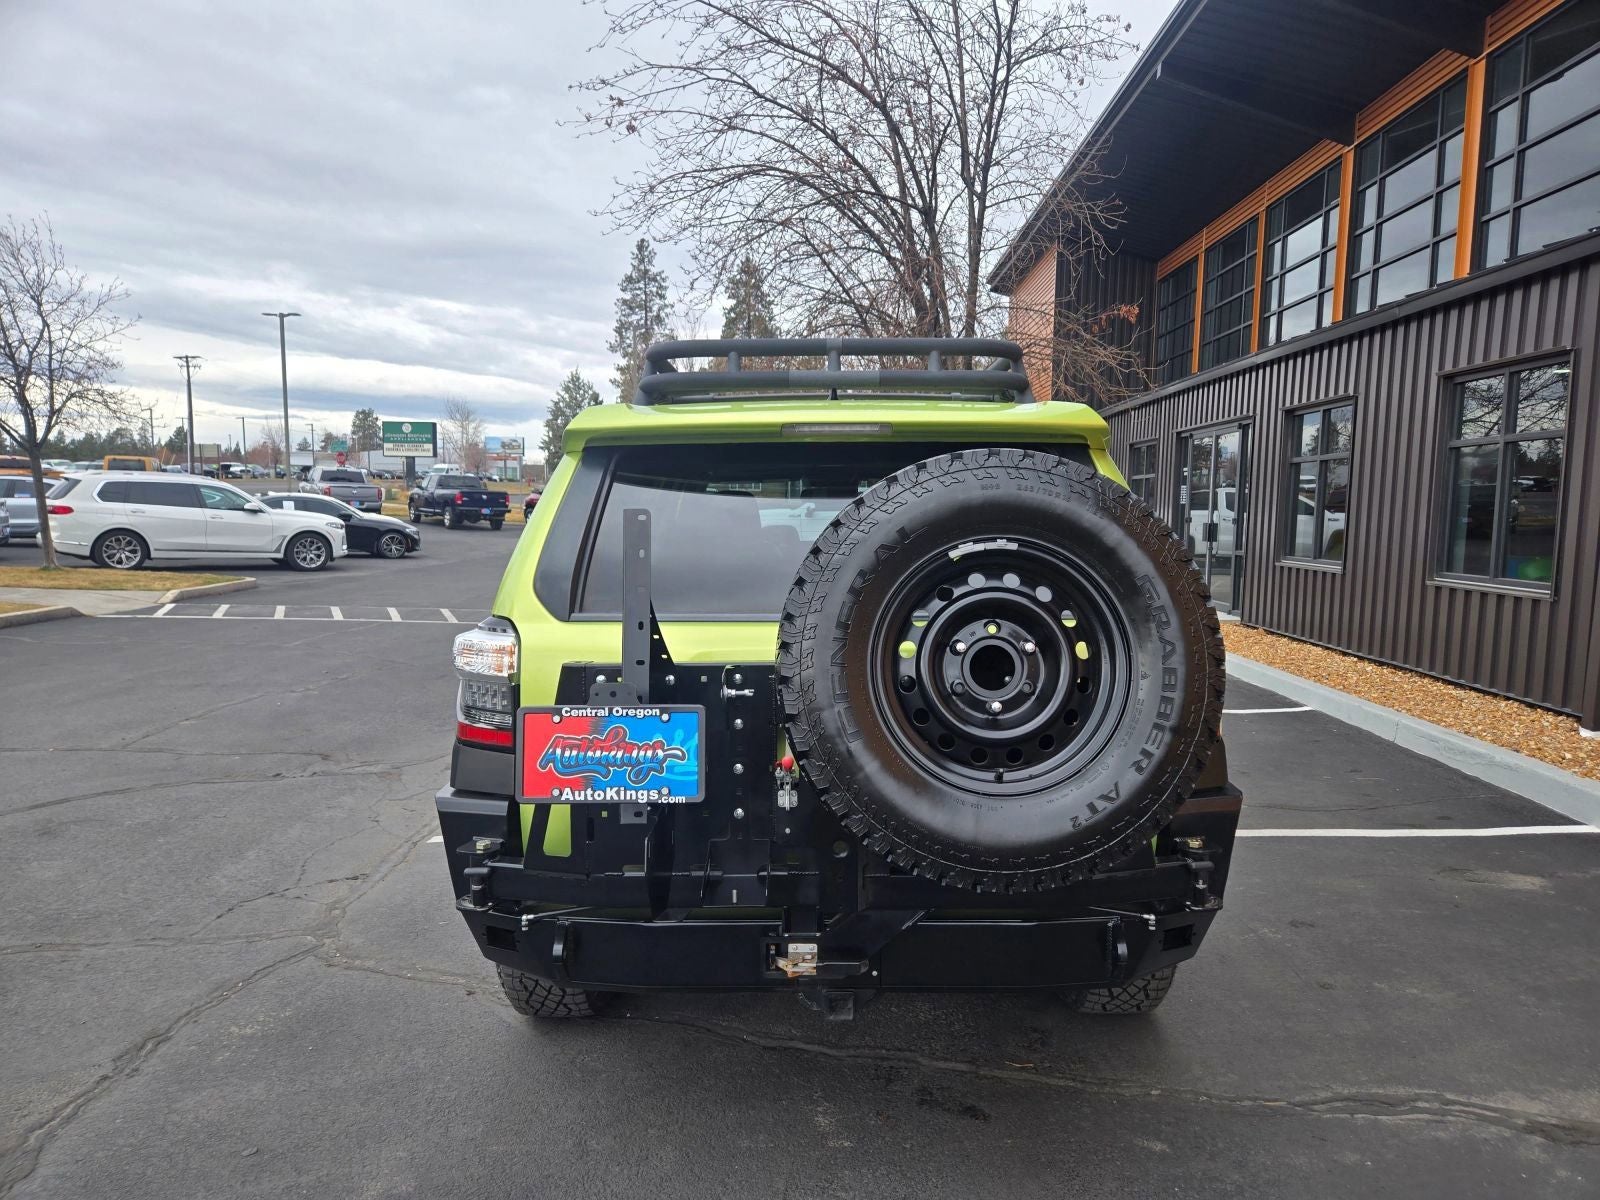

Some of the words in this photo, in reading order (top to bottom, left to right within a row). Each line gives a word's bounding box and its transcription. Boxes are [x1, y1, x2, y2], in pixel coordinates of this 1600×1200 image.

[562, 707, 609, 717] Central
[612, 707, 660, 719] Oregon
[829, 524, 929, 744] GENERAL
[1128, 573, 1180, 776] GRABBER
